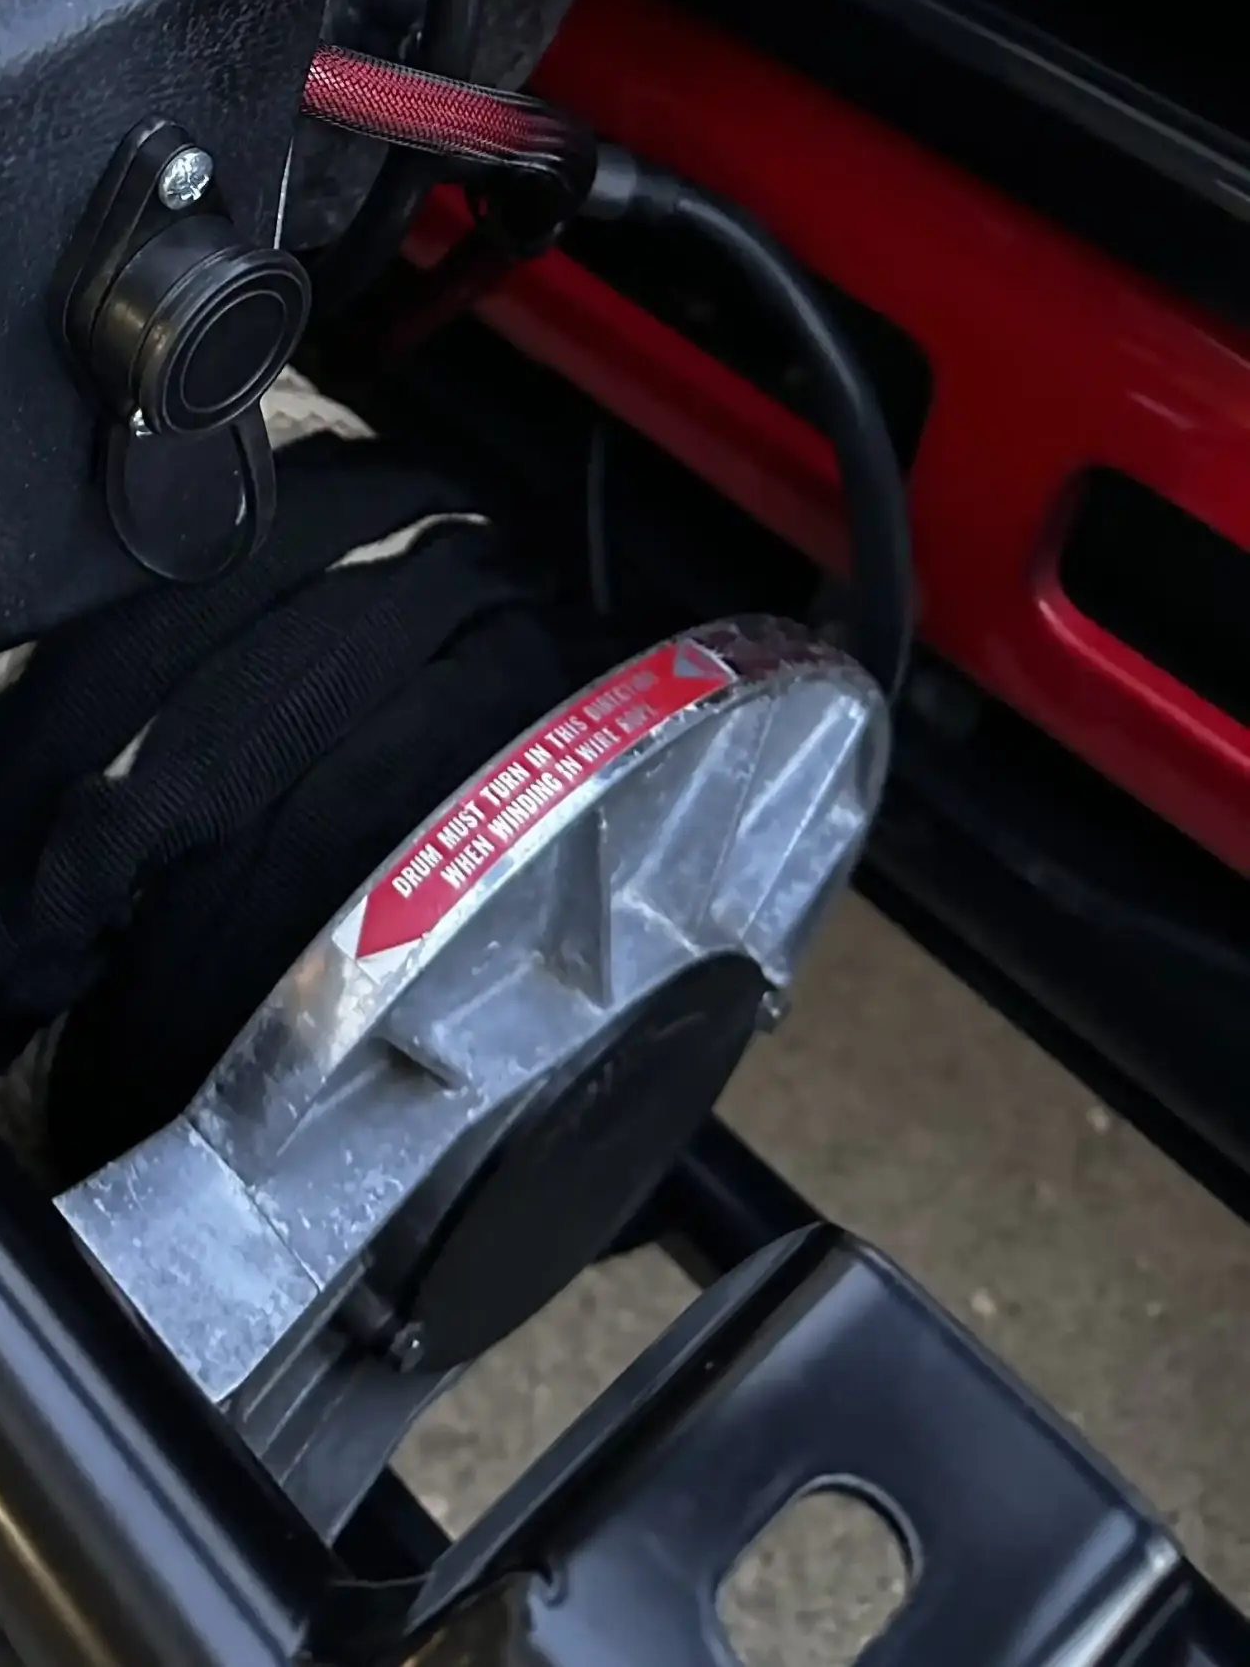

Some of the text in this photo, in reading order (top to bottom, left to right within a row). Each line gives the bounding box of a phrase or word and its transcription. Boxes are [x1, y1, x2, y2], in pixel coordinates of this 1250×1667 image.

[392, 670, 656, 898] DRUM MUST TURN IN THIS DIRECT
[440, 834, 495, 890] WHEN
[488, 771, 564, 844] WINDING
[555, 755, 584, 783] IN
[576, 725, 622, 765] WIRE
